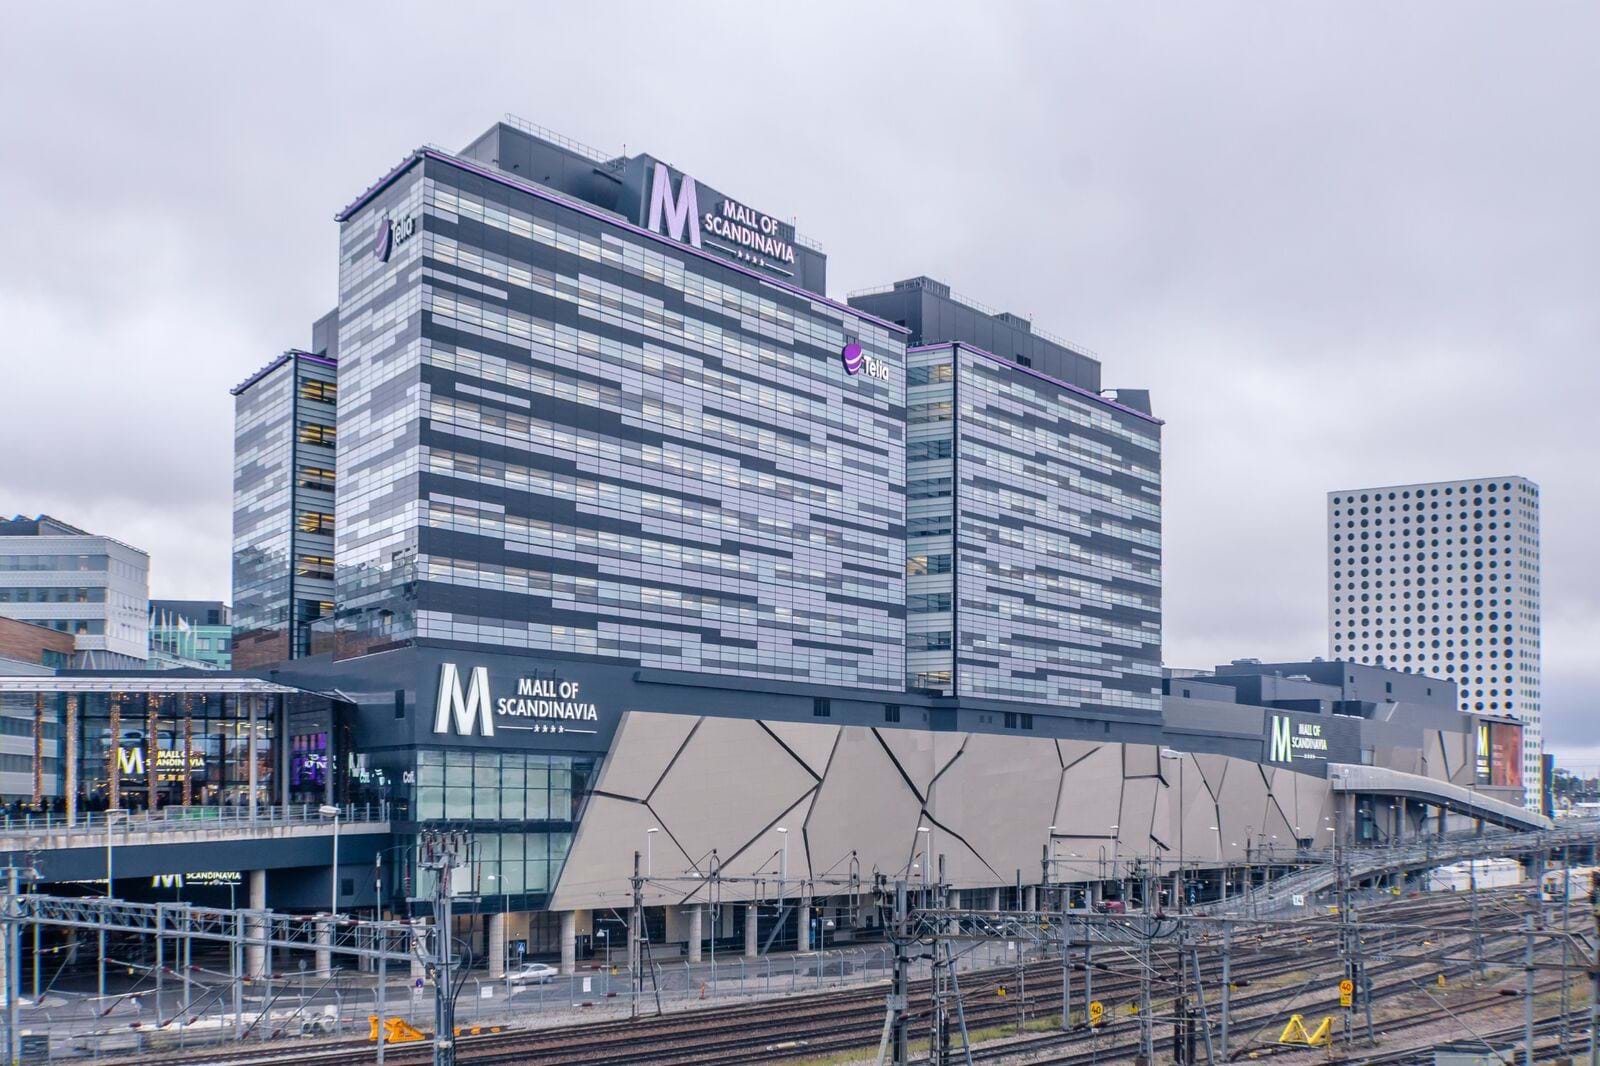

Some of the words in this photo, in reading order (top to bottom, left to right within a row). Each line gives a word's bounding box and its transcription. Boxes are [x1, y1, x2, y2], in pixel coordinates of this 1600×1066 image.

[648, 162, 702, 249] M
[723, 199, 758, 228] MALL
[760, 215, 778, 236] OF
[704, 212, 795, 264] SCANDINAVIA
[863, 355, 889, 380] Telia
[433, 662, 495, 737] M
[517, 678, 557, 698] MALL
[559, 682, 579, 699] OF
[497, 698, 598, 721] SCANDINAVIA
[1270, 715, 1292, 762] M
[1298, 723, 1313, 736] MALL
[1313, 725, 1321, 737] OF
[1291, 736, 1328, 750] SCANDINAVIA
[117, 746, 145, 774] M
[145, 758, 206, 766] SANDINVIA
[186, 871, 241, 880] SCANDINAVIA
[1341, 982, 1351, 991] 40
